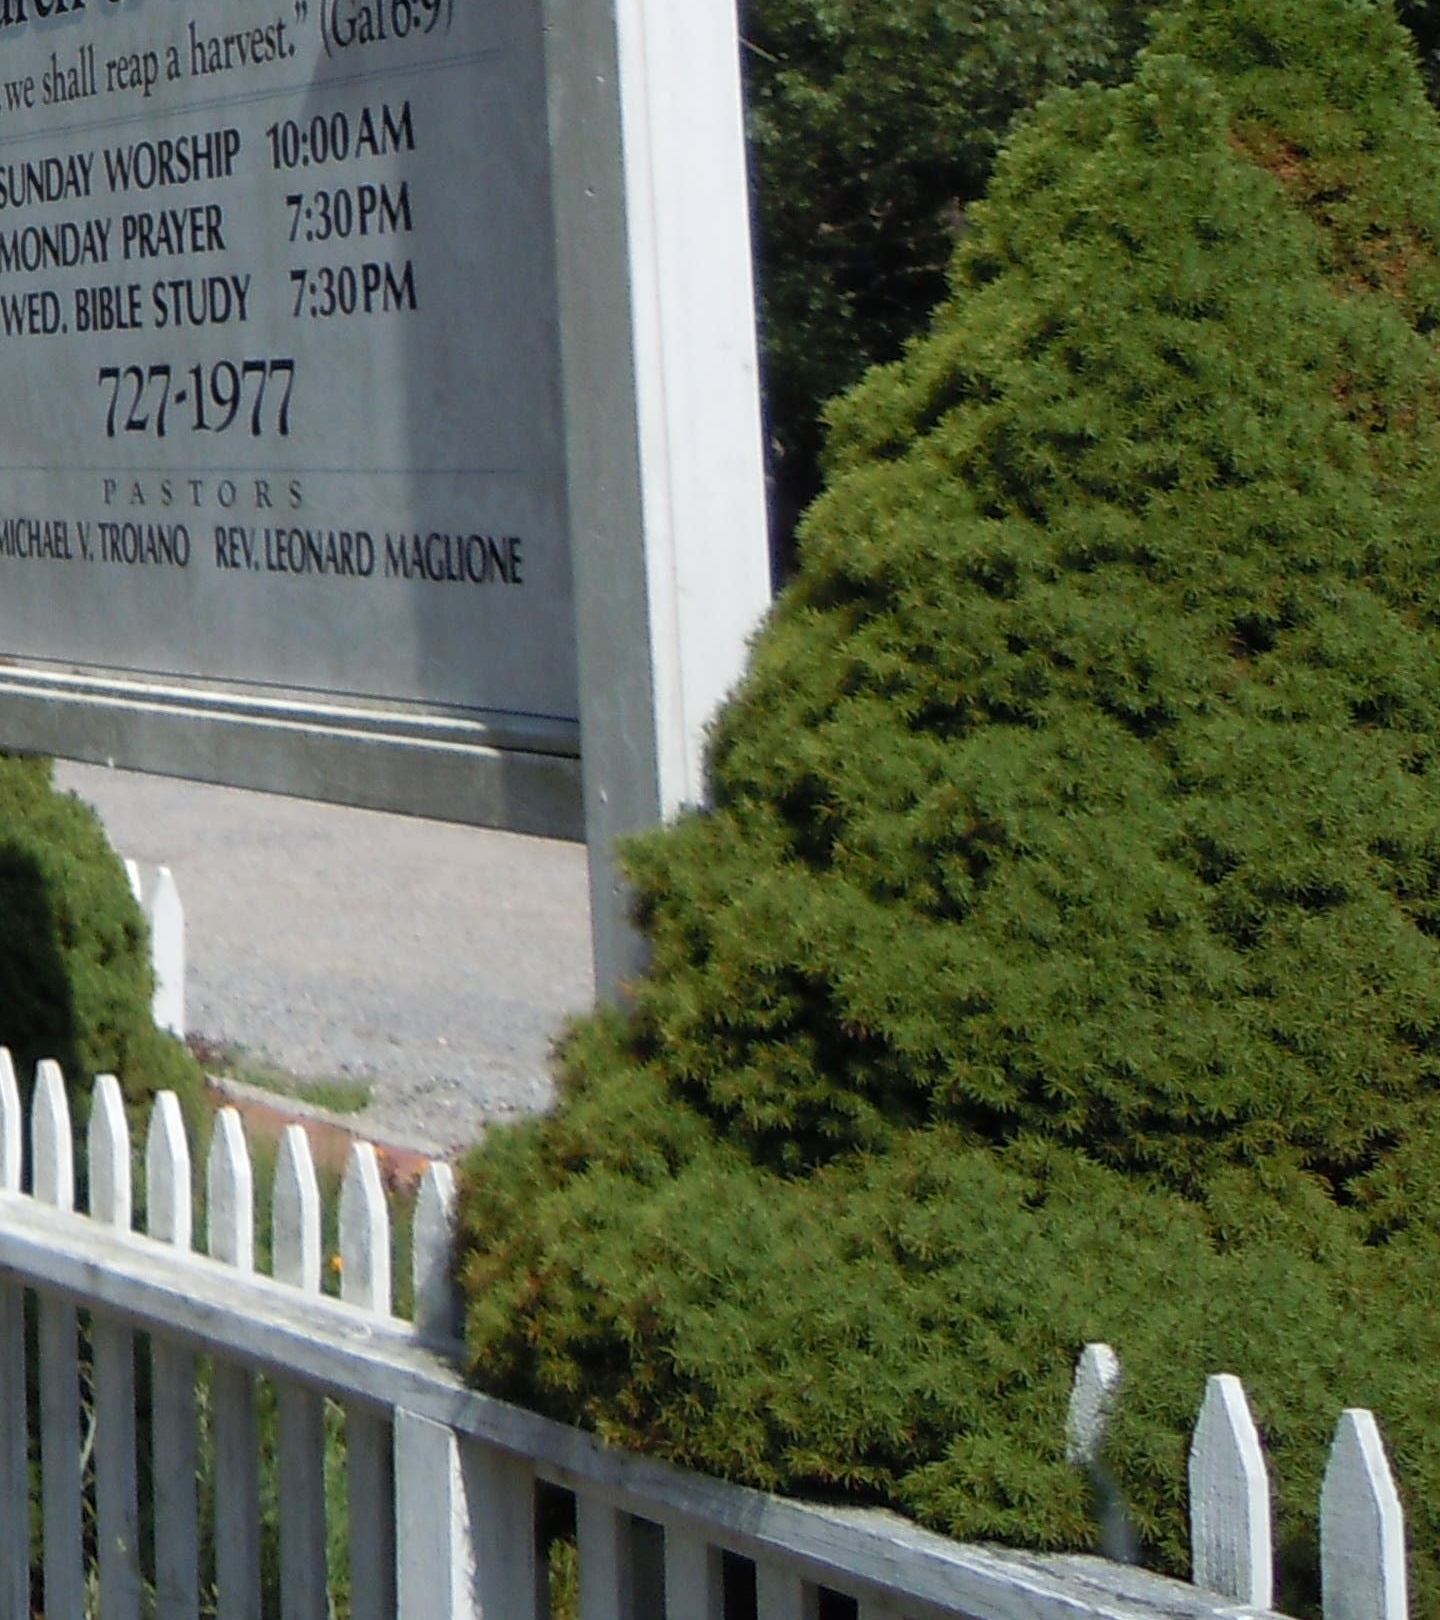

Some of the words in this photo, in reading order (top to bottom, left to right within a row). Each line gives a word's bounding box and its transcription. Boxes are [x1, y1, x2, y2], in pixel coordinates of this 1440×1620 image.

[42, 43, 97, 105] shall
[105, 49, 159, 97] reap
[166, 45, 181, 80] a
[188, 0, 308, 76] harvest."
[103, 127, 241, 192] WORSHIP
[266, 111, 349, 169] 10:00
[355, 100, 415, 158] AM
[122, 204, 226, 260] PRAYER
[286, 188, 353, 242] 7:30
[358, 181, 413, 235] PM
[0, 290, 68, 336] WED.
[74, 283, 143, 332] BIBLE
[152, 274, 251, 329] STUDY
[290, 265, 357, 318] 7:30
[361, 259, 418, 314] PM
[98, 358, 295, 437] 727-1977
[103, 479, 303, 509] PASTORS
[76, 521, 95, 561] V.
[98, 522, 190, 567] TROIANO
[214, 526, 260, 571] REV.
[265, 528, 375, 577] LEONARD
[384, 532, 525, 584] MAGLIONE
